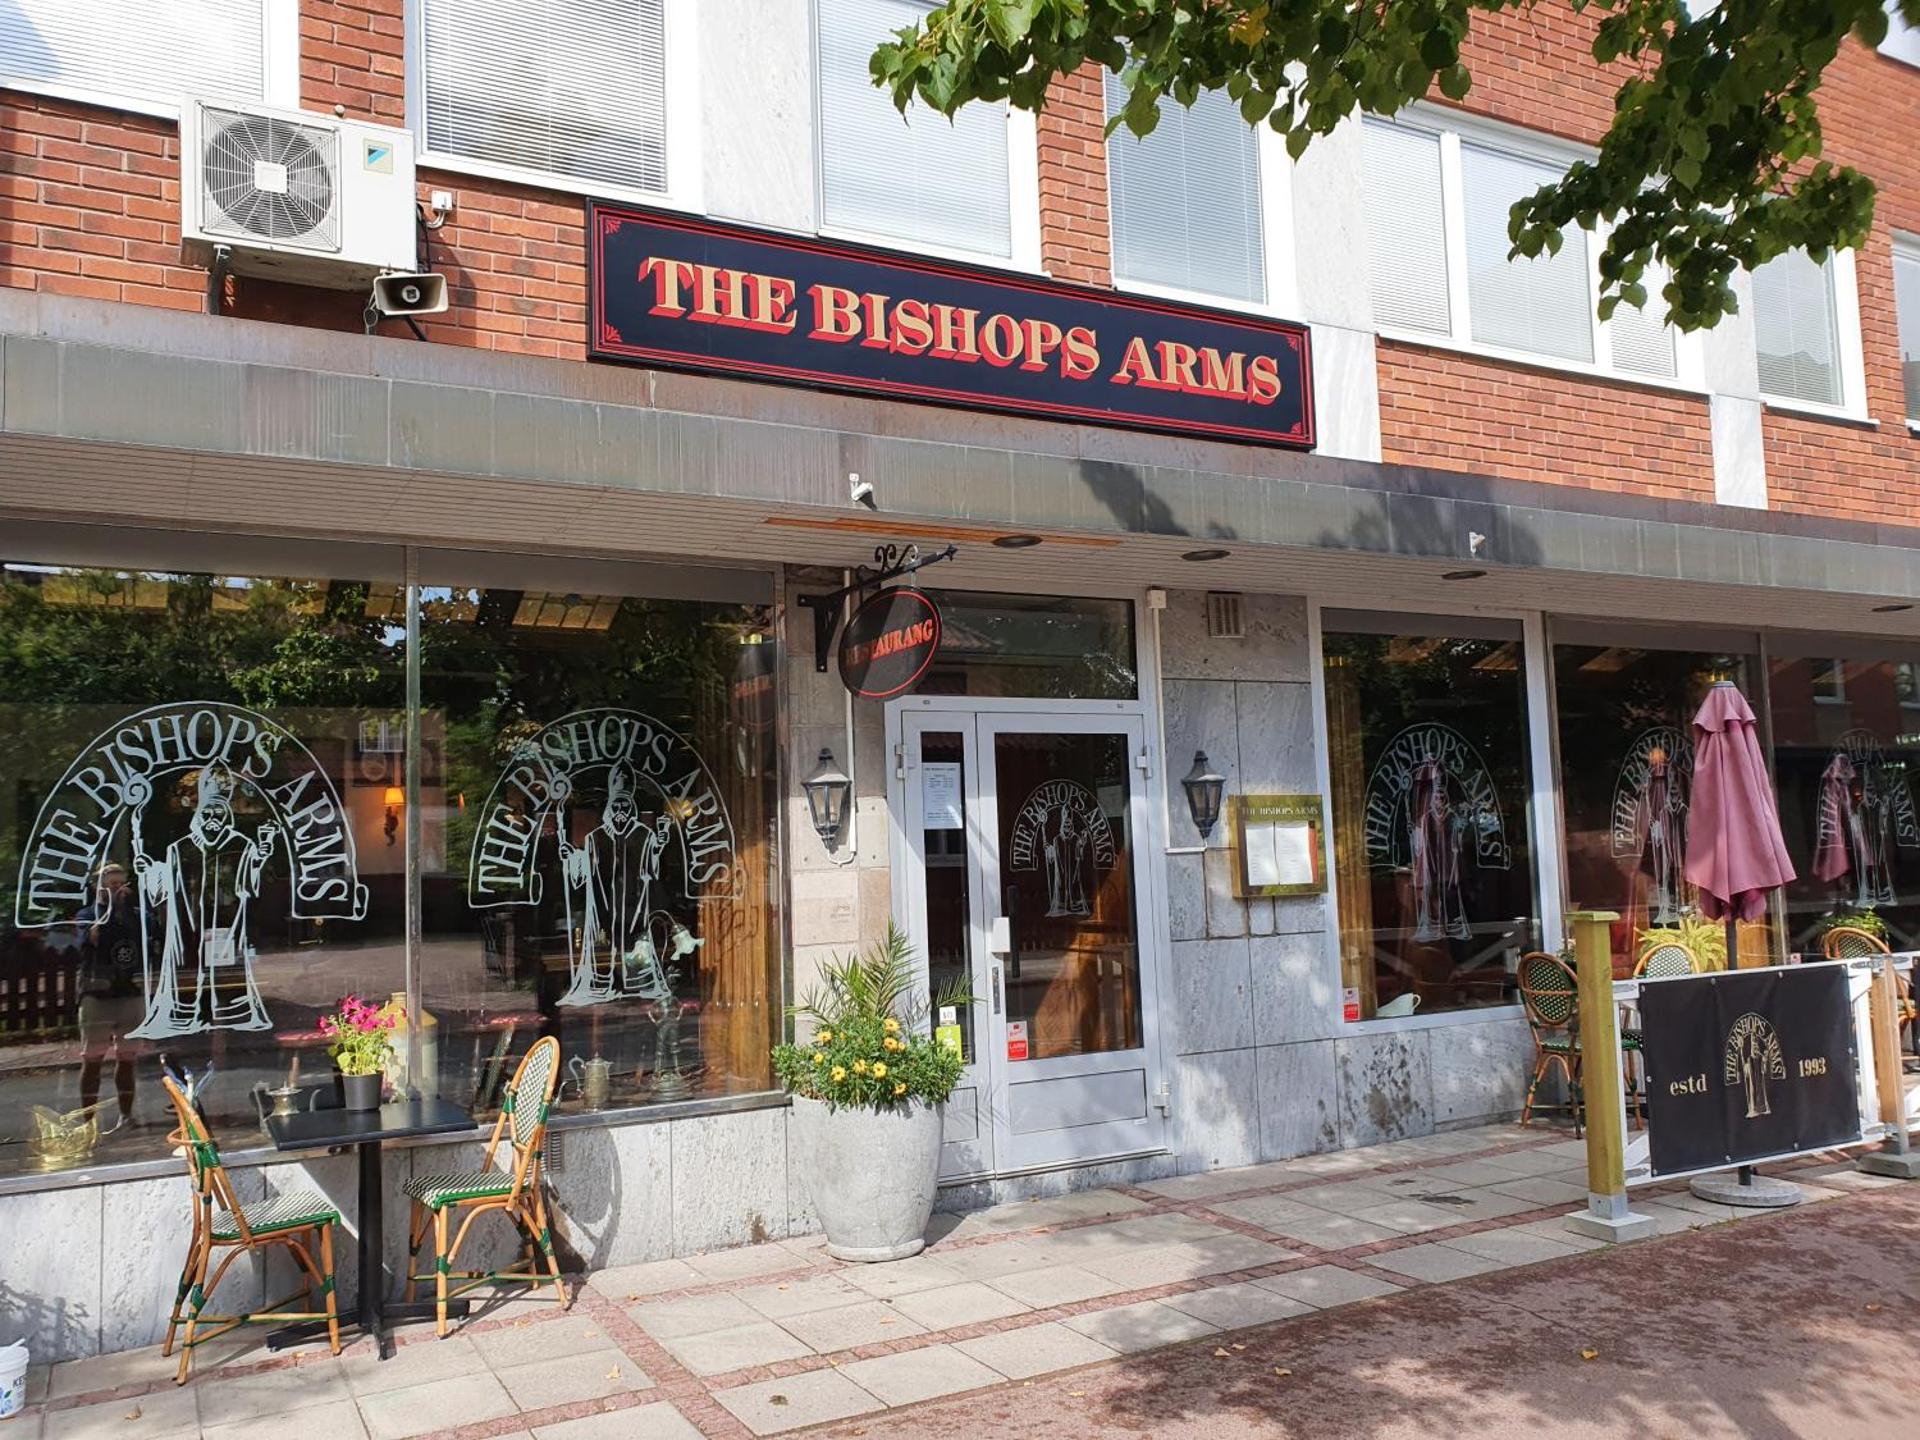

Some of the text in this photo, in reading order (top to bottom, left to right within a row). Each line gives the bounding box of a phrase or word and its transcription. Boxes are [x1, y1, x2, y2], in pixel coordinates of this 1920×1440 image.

[638, 256, 1282, 406] THE BISHOPS ARMS
[845, 619, 934, 666] TAURANG
[1377, 727, 1469, 798] BISHOPS
[28, 709, 352, 912] THE BISHOPS ARMS
[478, 715, 732, 894] THE BISHOPS ARMS
[1013, 783, 1113, 865] THE BISHOPS ARMS
[1366, 792, 1393, 861] THE
[1614, 790, 1639, 850] THE
[1669, 1056, 1827, 1096] estd 1993
[1726, 1016, 1782, 1081] THE BISHOPS ARMS
